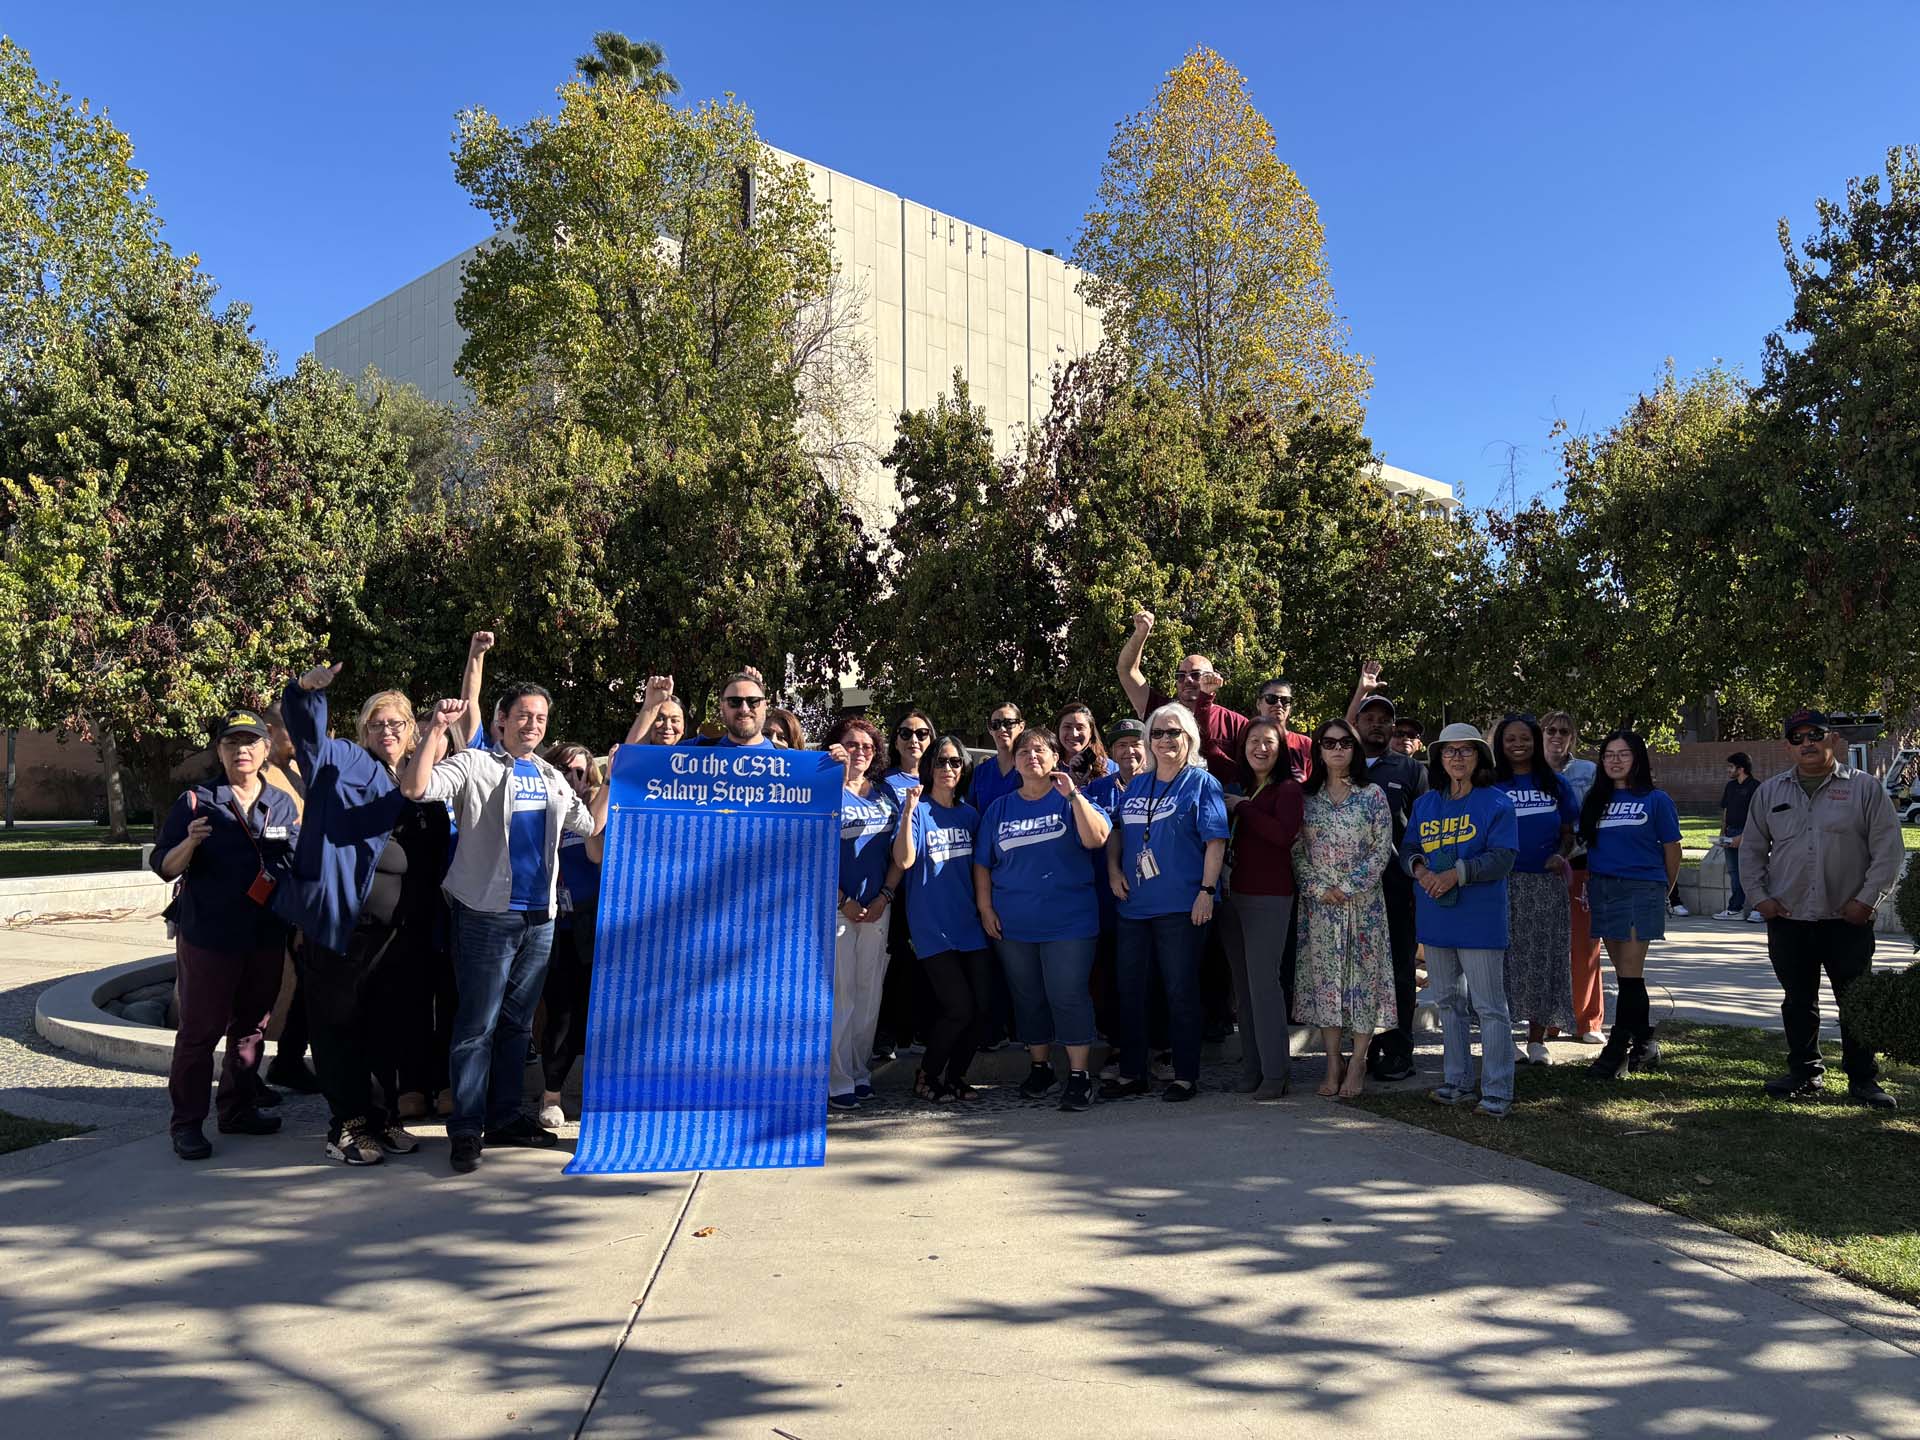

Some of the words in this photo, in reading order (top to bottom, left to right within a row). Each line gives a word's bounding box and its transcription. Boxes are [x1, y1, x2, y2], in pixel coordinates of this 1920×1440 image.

[669, 752, 698, 775] To
[699, 752, 728, 778] the
[732, 755, 791, 778] CSU:
[512, 775, 546, 793] SUE
[644, 778, 708, 806] Salary
[710, 779, 765, 807] Steps
[767, 782, 812, 805] Now
[1505, 789, 1552, 803] SUEU
[1602, 802, 1645, 815] UEU
[998, 813, 1059, 835] CSUEU
[1420, 814, 1470, 837] CSUEU
[926, 828, 971, 847] CSUEU
